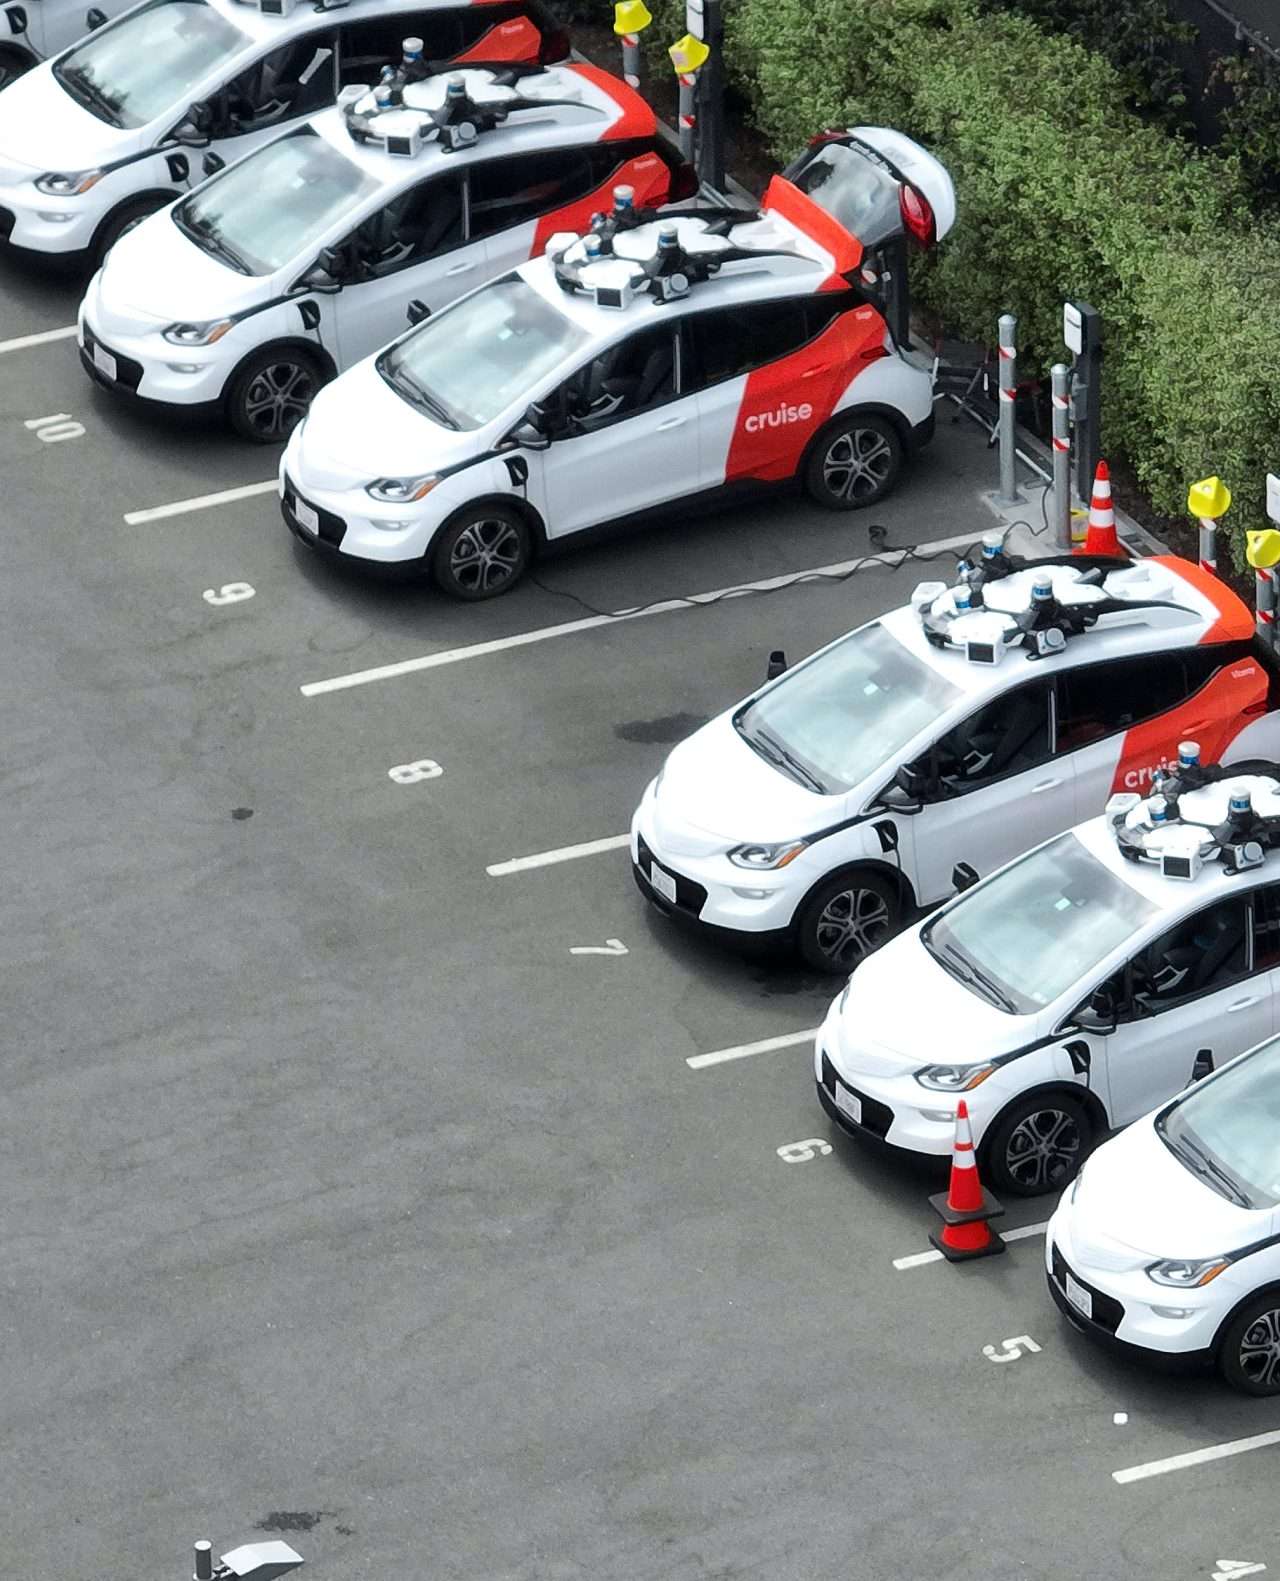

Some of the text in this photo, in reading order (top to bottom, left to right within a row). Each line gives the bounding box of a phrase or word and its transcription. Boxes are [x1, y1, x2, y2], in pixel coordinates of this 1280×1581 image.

[23, 413, 86, 443] 10
[744, 400, 813, 434] cruise
[202, 582, 256, 606] 9
[387, 759, 443, 784] 8
[569, 938, 629, 956] 7
[776, 1139, 832, 1163] 6
[982, 1335, 1042, 1362] 5
[1211, 1560, 1267, 1581] 4
